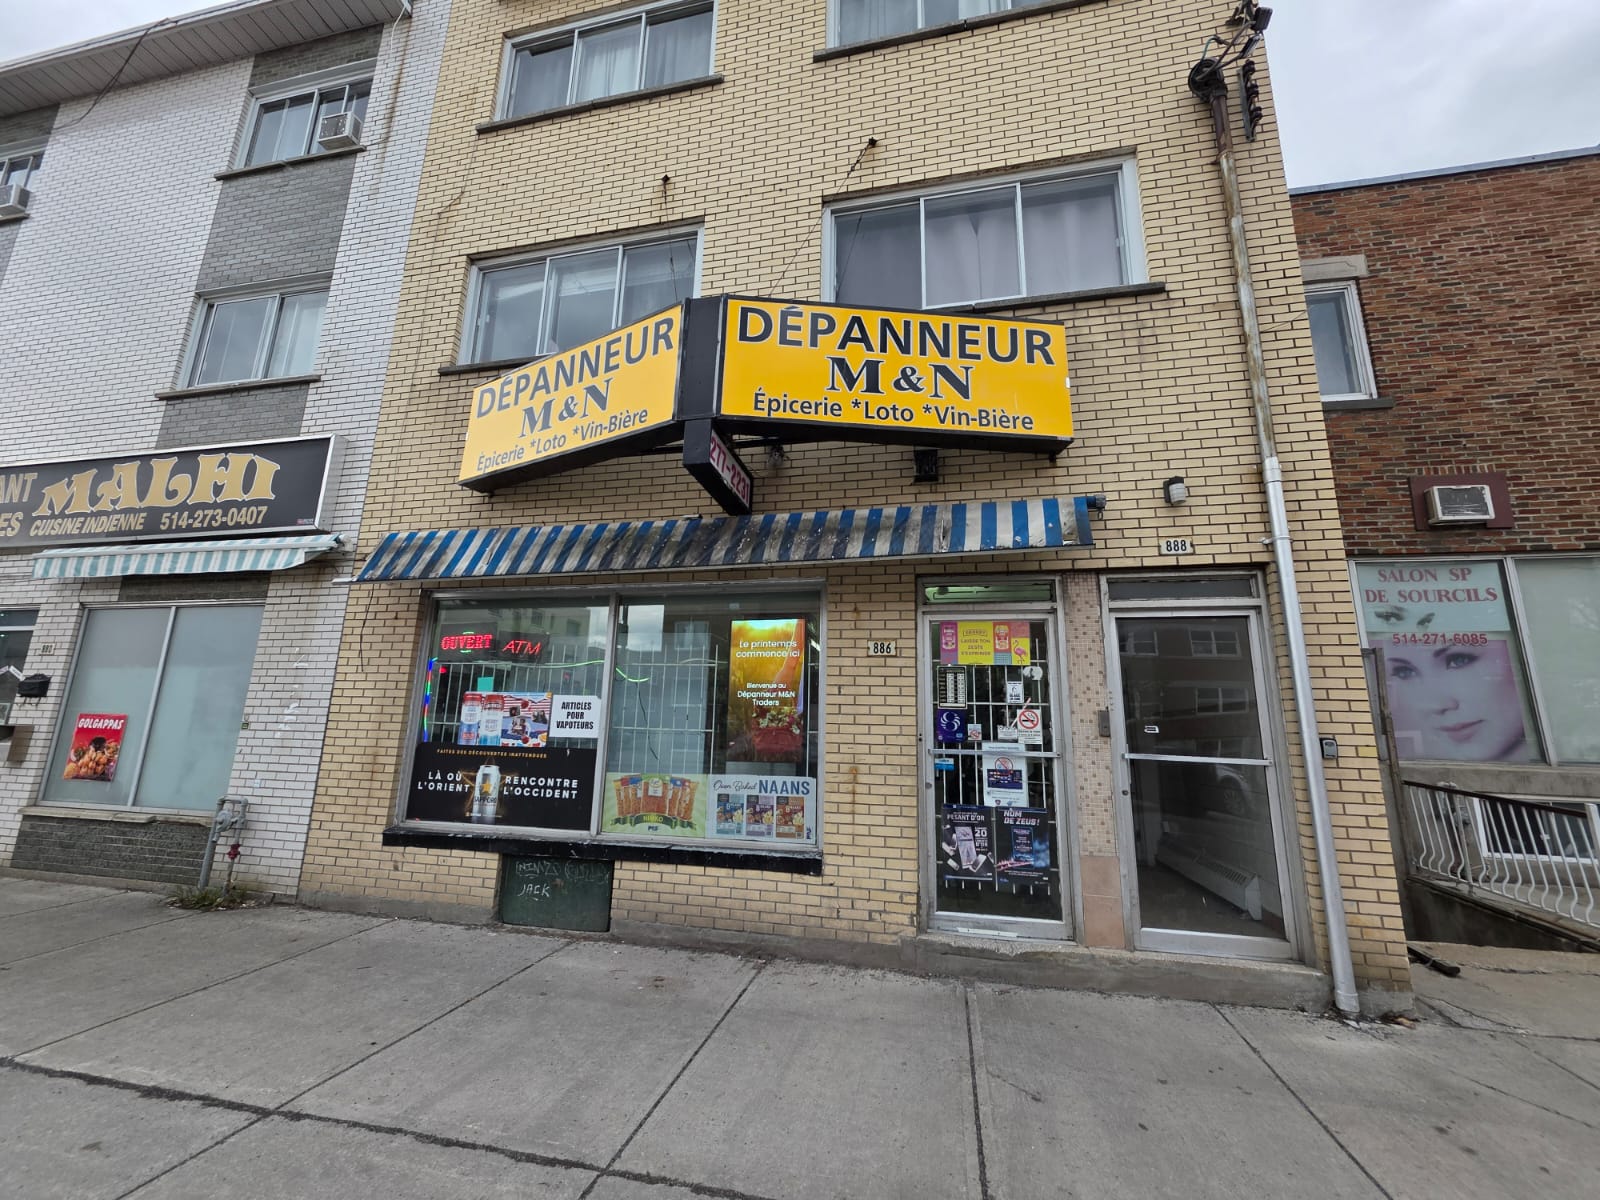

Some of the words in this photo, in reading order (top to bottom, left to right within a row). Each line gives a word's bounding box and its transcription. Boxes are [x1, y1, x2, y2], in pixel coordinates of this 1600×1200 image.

[737, 304, 1055, 367] DÉPANNEUR
[476, 316, 675, 418] DÉPANNEUR
[753, 386, 842, 418] Épicerie
[477, 444, 525, 474] Épicerie
[710, 436, 750, 504] 277-2231
[32, 453, 280, 517] MALHI
[30, 517, 84, 536] CUISINE
[82, 512, 147, 534] INDIENNE
[160, 506, 268, 531] 514-273-0407
[1165, 540, 1187, 553] 888
[1378, 568, 1438, 583] SALON
[1449, 567, 1472, 582] SP
[1365, 589, 1389, 603] DE
[1398, 587, 1498, 603] SOURCILS
[441, 634, 493, 650] OUVERT
[739, 640, 749, 648] Le
[751, 640, 797, 650] printemps
[1392, 633, 1488, 645] 514-271-6085
[502, 640, 542, 655] ATM
[736, 650, 788, 658] commence
[789, 649, 800, 657] ici
[872, 641, 892, 655] 886
[737, 691, 776, 699] Dépanneur
[561, 701, 592, 711] ARTICLES
[566, 711, 585, 720] POUR
[78, 718, 125, 730] GOLGAPPAS
[556, 720, 594, 730] VAPOTEURS
[428, 769, 442, 780] LÀ
[447, 771, 462, 781] OÙ
[505, 775, 578, 788] RENCONTRE
[418, 781, 470, 793] L'ORIENT
[503, 786, 577, 799] L'OCCIDENT
[758, 779, 810, 795] NAANS
[975, 829, 987, 837] 20
[517, 883, 550, 897] JACK
